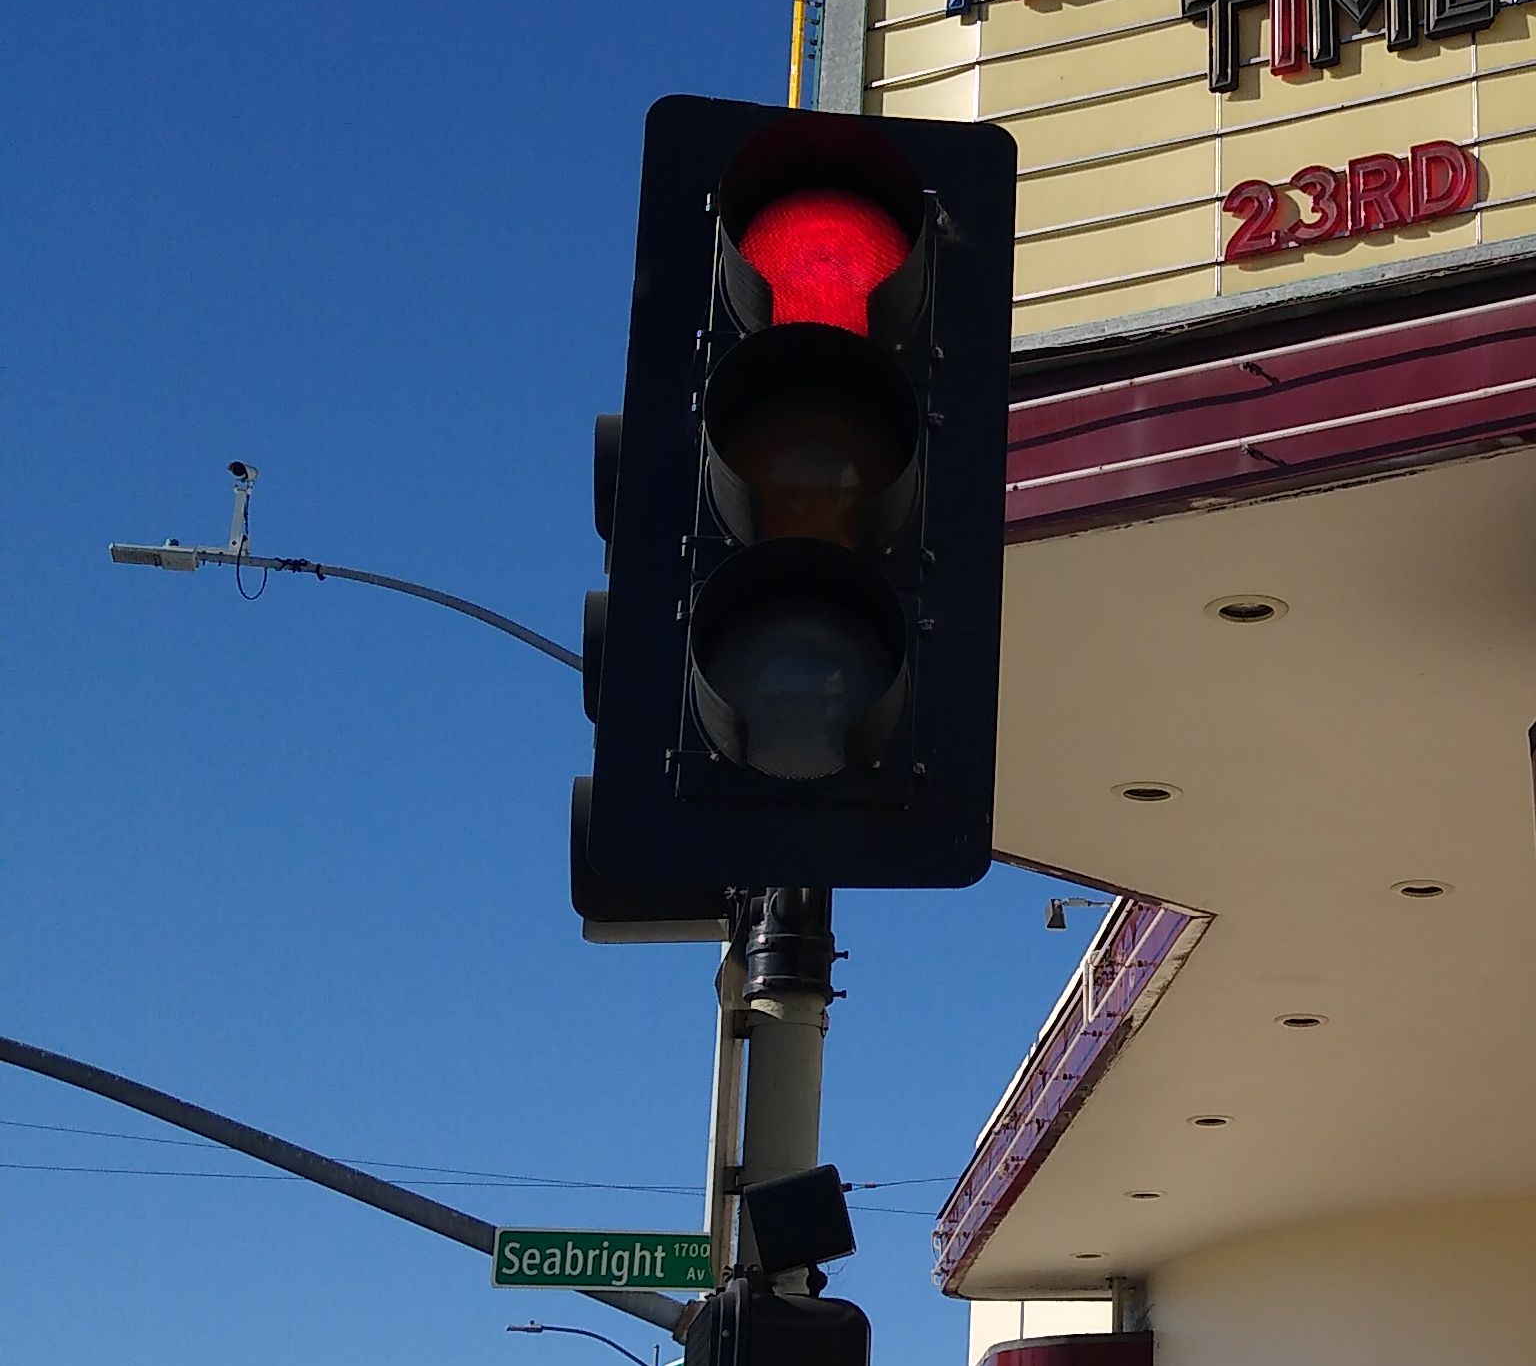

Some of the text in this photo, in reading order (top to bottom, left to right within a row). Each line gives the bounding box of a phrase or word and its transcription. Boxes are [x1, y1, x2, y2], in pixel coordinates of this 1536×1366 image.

[1220, 139, 1478, 263] 23RD
[501, 1240, 710, 1286] Seabright 1700
[686, 1266, 706, 1281] Av
